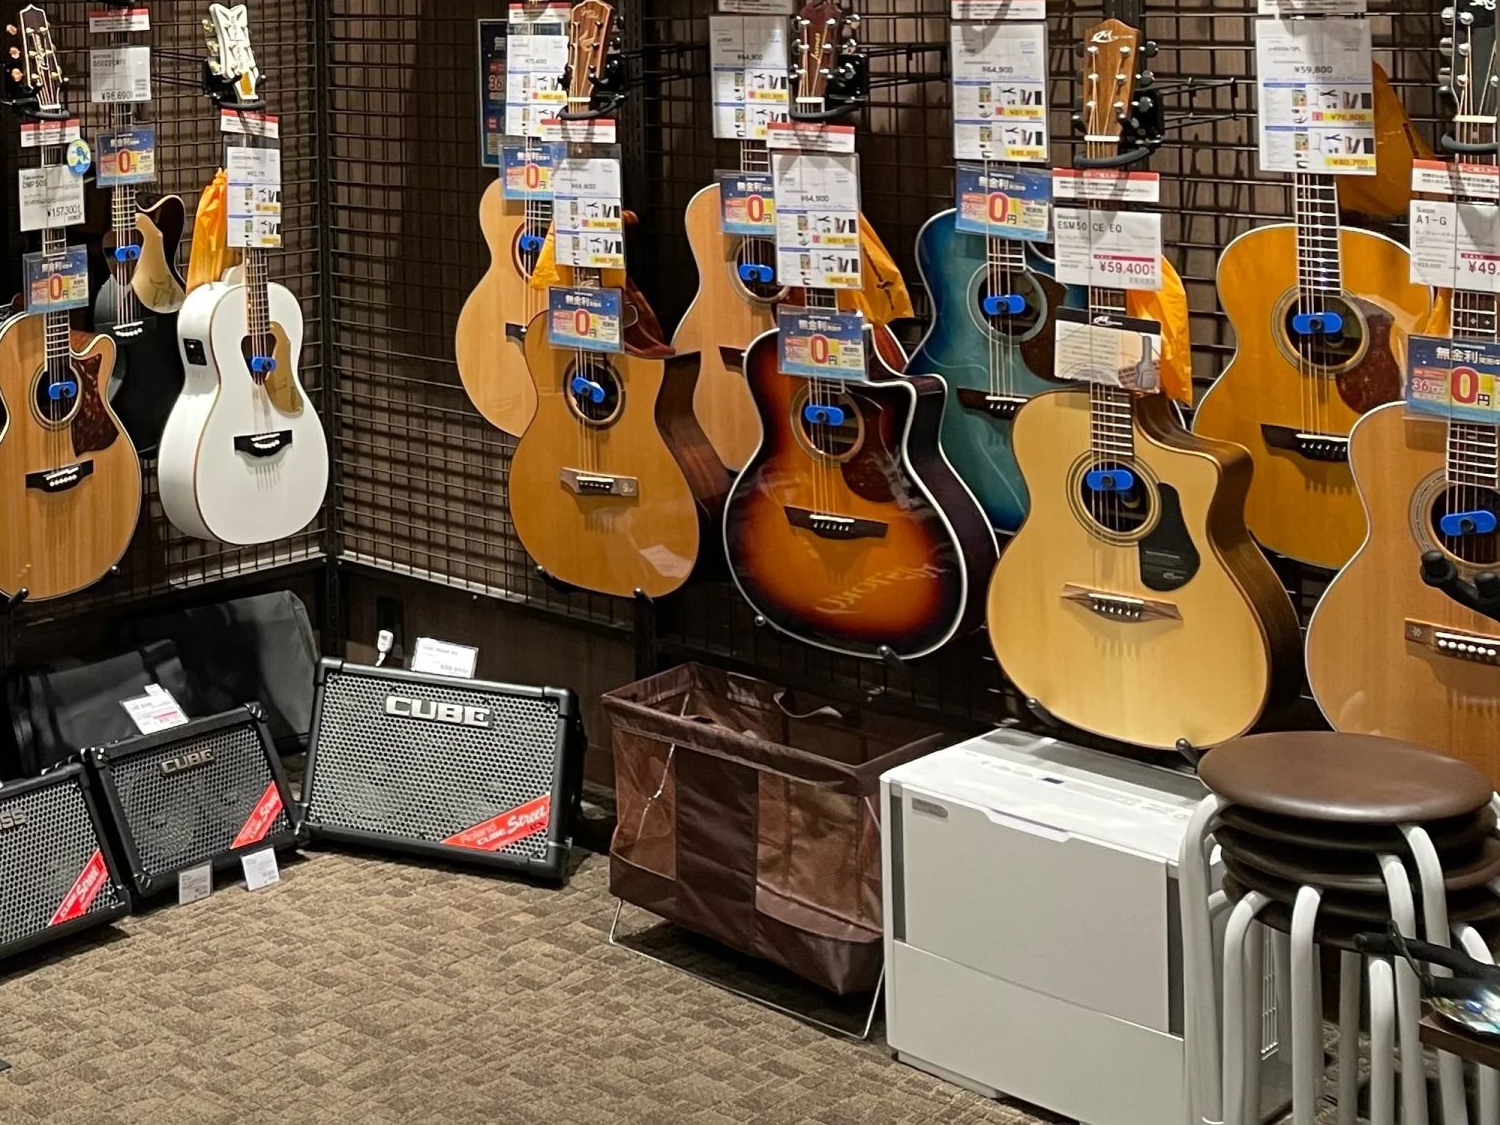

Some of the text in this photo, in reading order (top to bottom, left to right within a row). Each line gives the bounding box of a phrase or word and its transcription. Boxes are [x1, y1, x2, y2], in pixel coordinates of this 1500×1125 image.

[385, 695, 491, 728] CUBE
[161, 748, 215, 774] CUBE
[507, 805, 547, 835] Street
